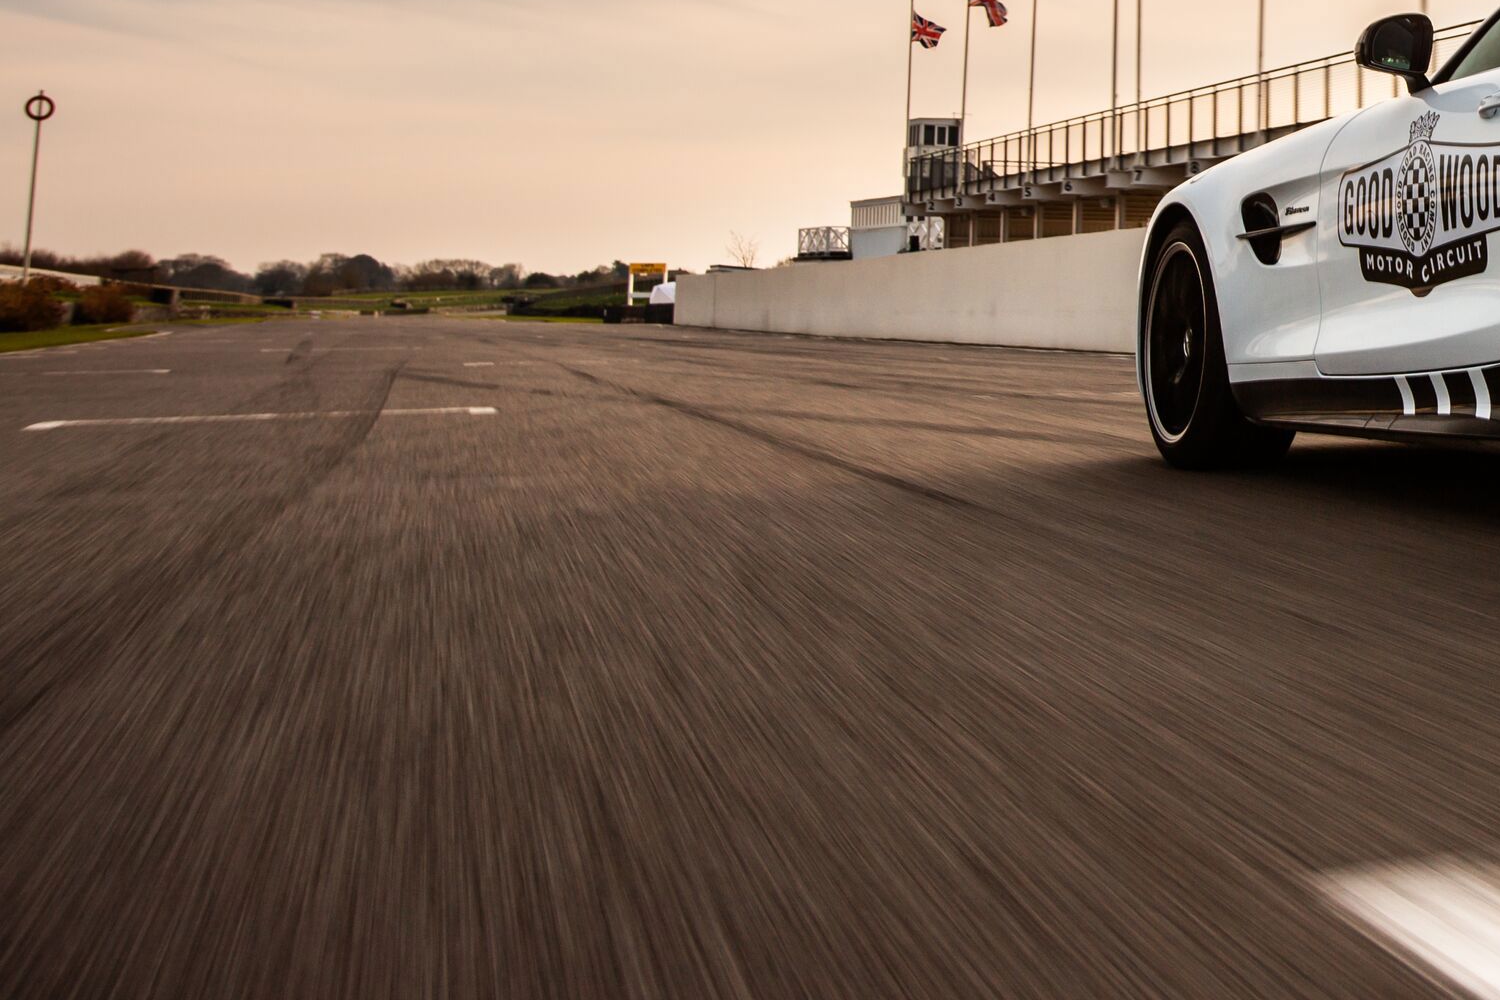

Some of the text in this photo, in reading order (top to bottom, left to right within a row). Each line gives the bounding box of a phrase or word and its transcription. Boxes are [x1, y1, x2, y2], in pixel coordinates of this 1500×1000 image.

[1135, 170, 1143, 181] 7
[1024, 186, 1032, 197] 5
[1064, 181, 1072, 192] 6
[955, 197, 963, 207] 3
[987, 192, 995, 202] 4
[1396, 144, 1436, 254] GOODWOOD ROAD RACING COMPANY
[928, 201, 935, 211] 2
[1344, 167, 1394, 239] GOOD
[1366, 241, 1483, 283] MOTOR CIRCUIT
